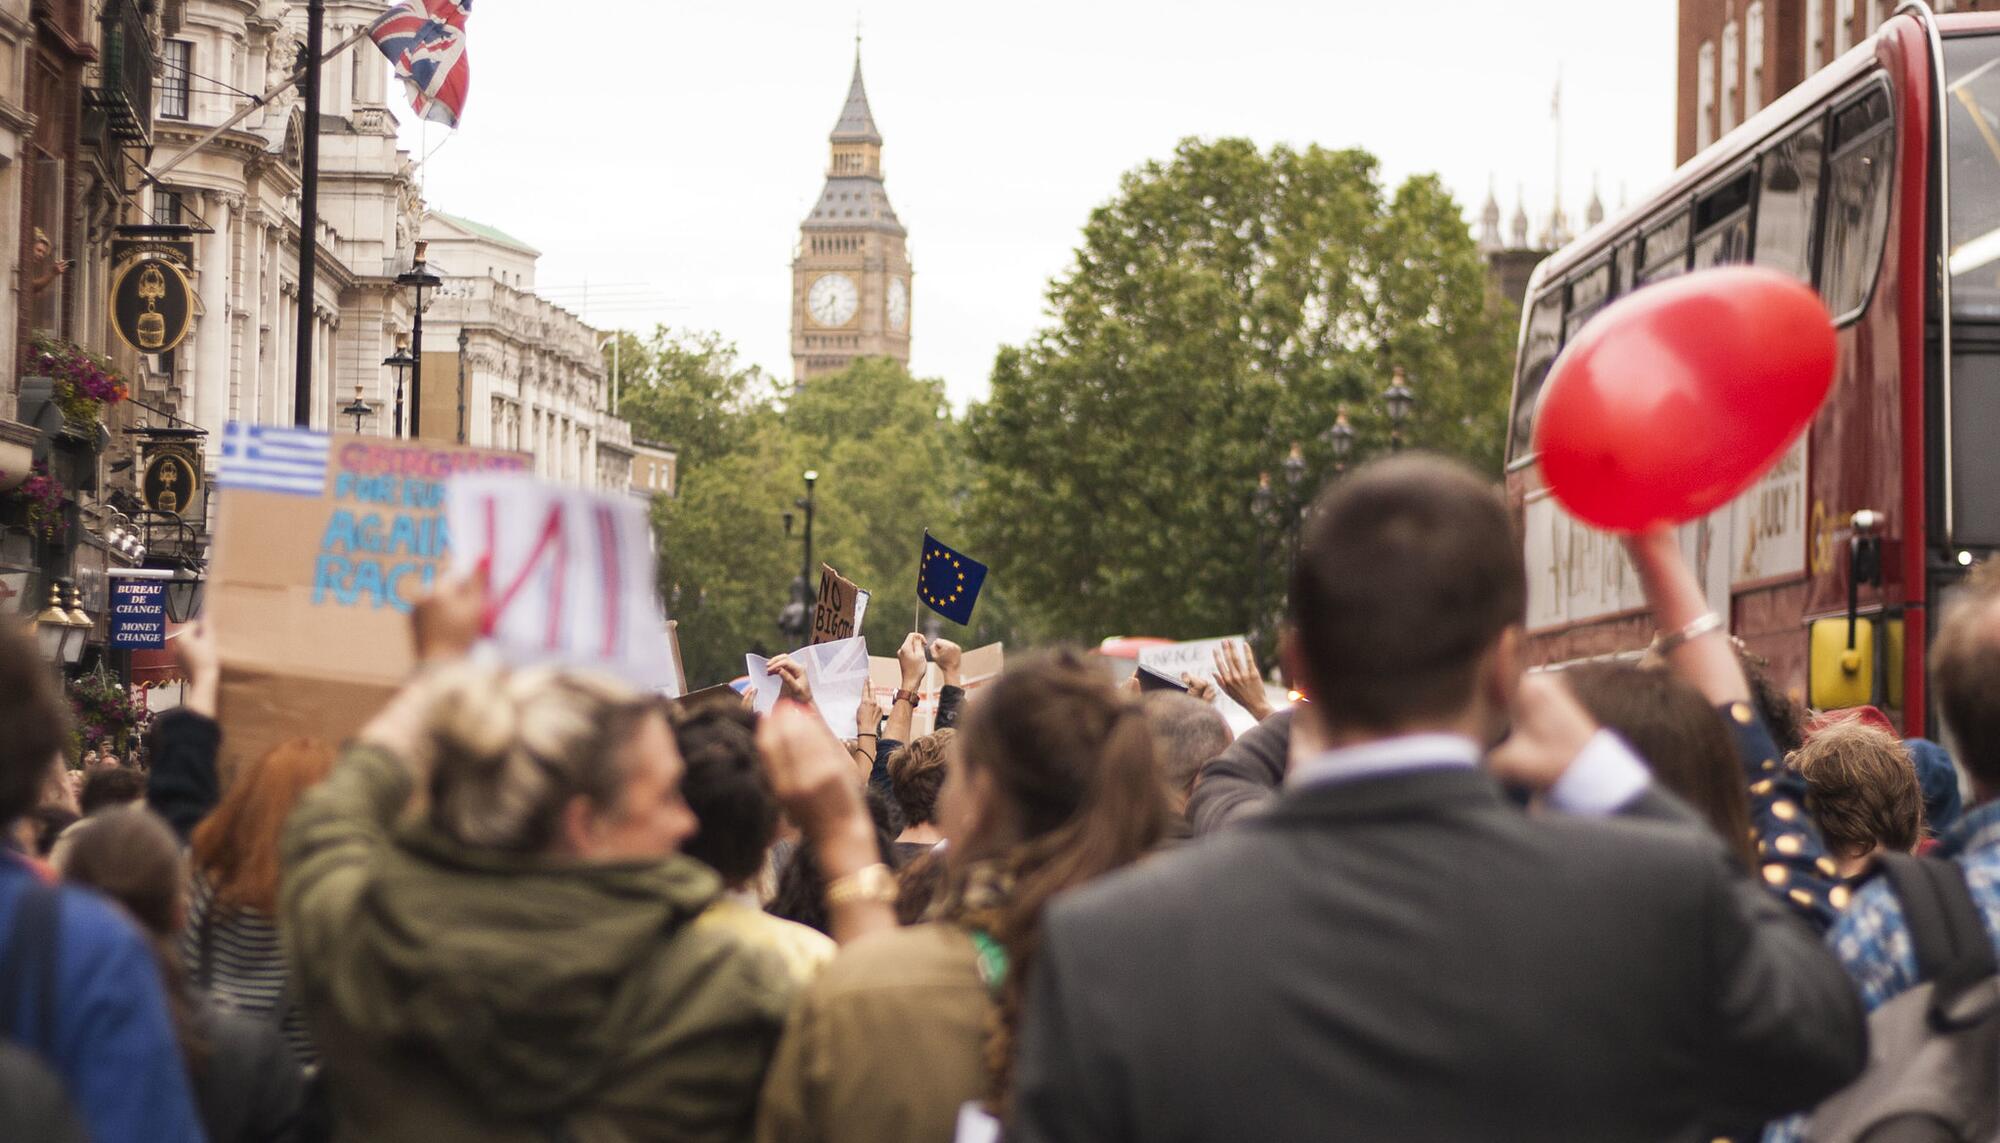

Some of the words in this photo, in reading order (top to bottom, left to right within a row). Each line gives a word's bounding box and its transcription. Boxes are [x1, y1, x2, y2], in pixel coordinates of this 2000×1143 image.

[335, 470, 396, 503] FOR
[117, 585, 163, 594] BUREAU
[819, 571, 842, 612] NO
[131, 595, 147, 604] DE
[116, 605, 162, 614] CHANGE
[120, 622, 160, 632] MONEY
[116, 633, 161, 642] CHANGE
